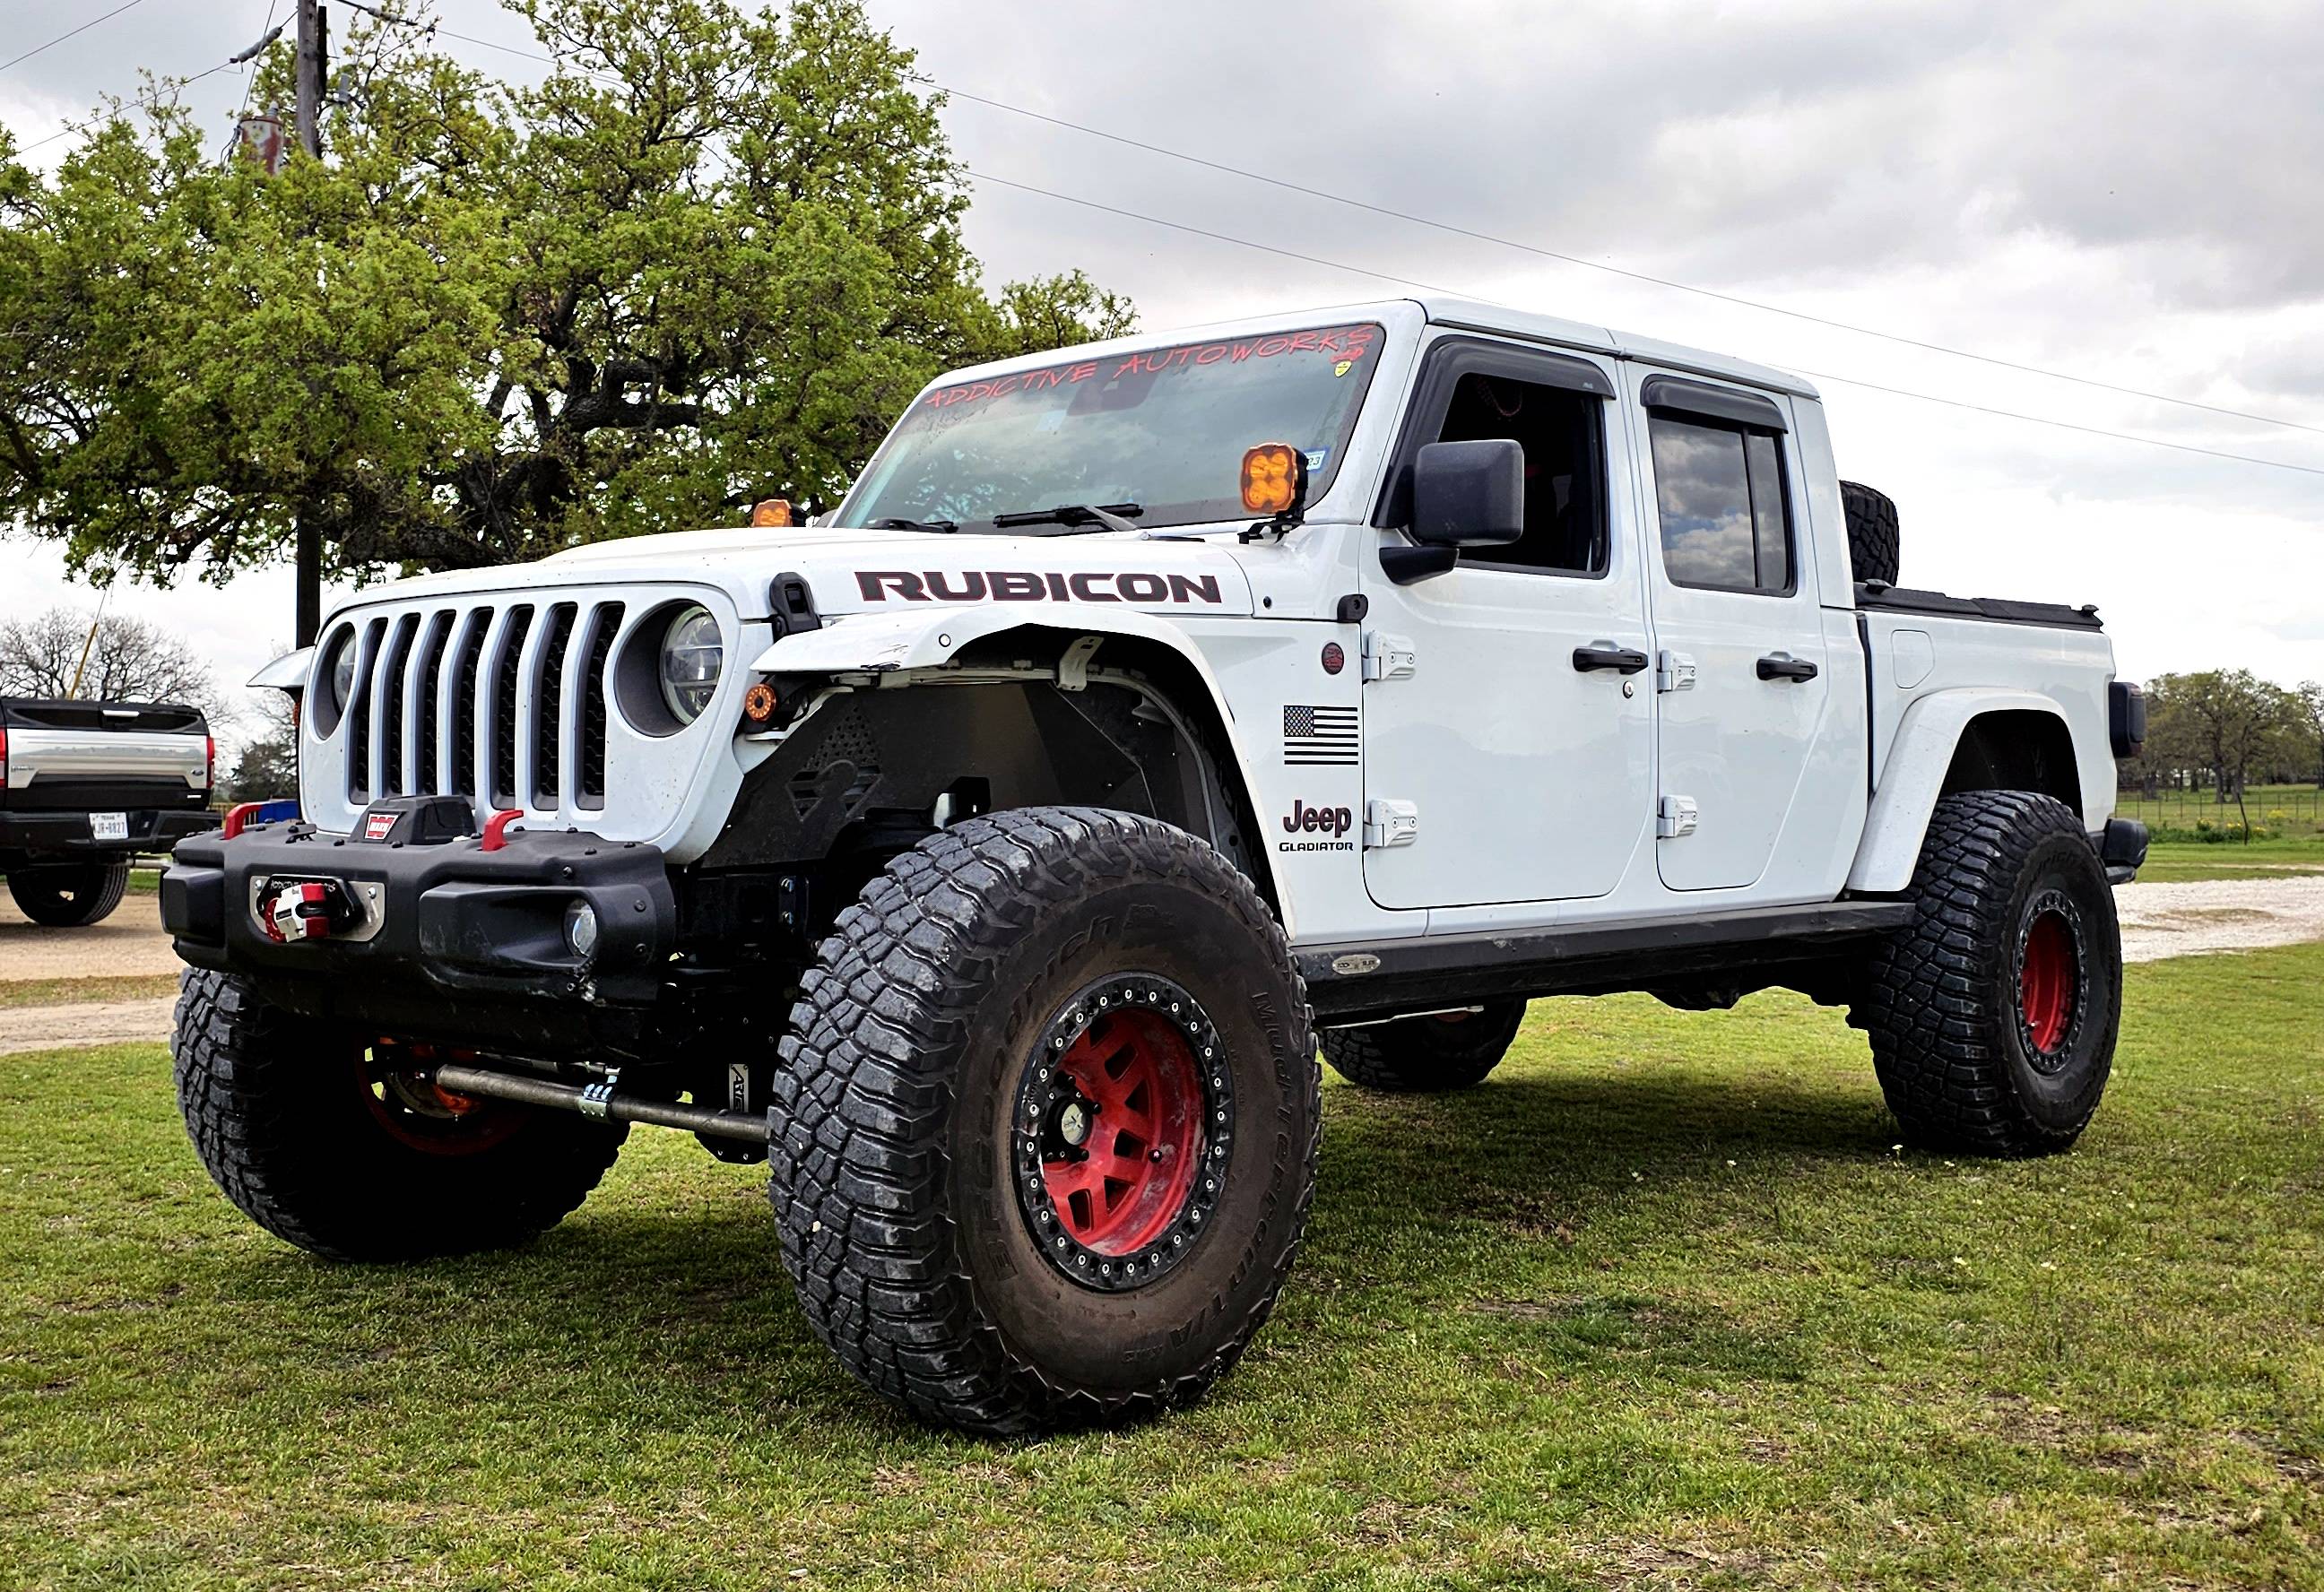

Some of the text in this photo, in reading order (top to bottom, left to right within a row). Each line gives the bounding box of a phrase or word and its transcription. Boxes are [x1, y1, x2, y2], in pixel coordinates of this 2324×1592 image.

[925, 324, 1374, 408] ADDICTIVE AUTOWORKS
[854, 571, 1223, 603] RUBICON
[1283, 800, 1351, 838] Jeep
